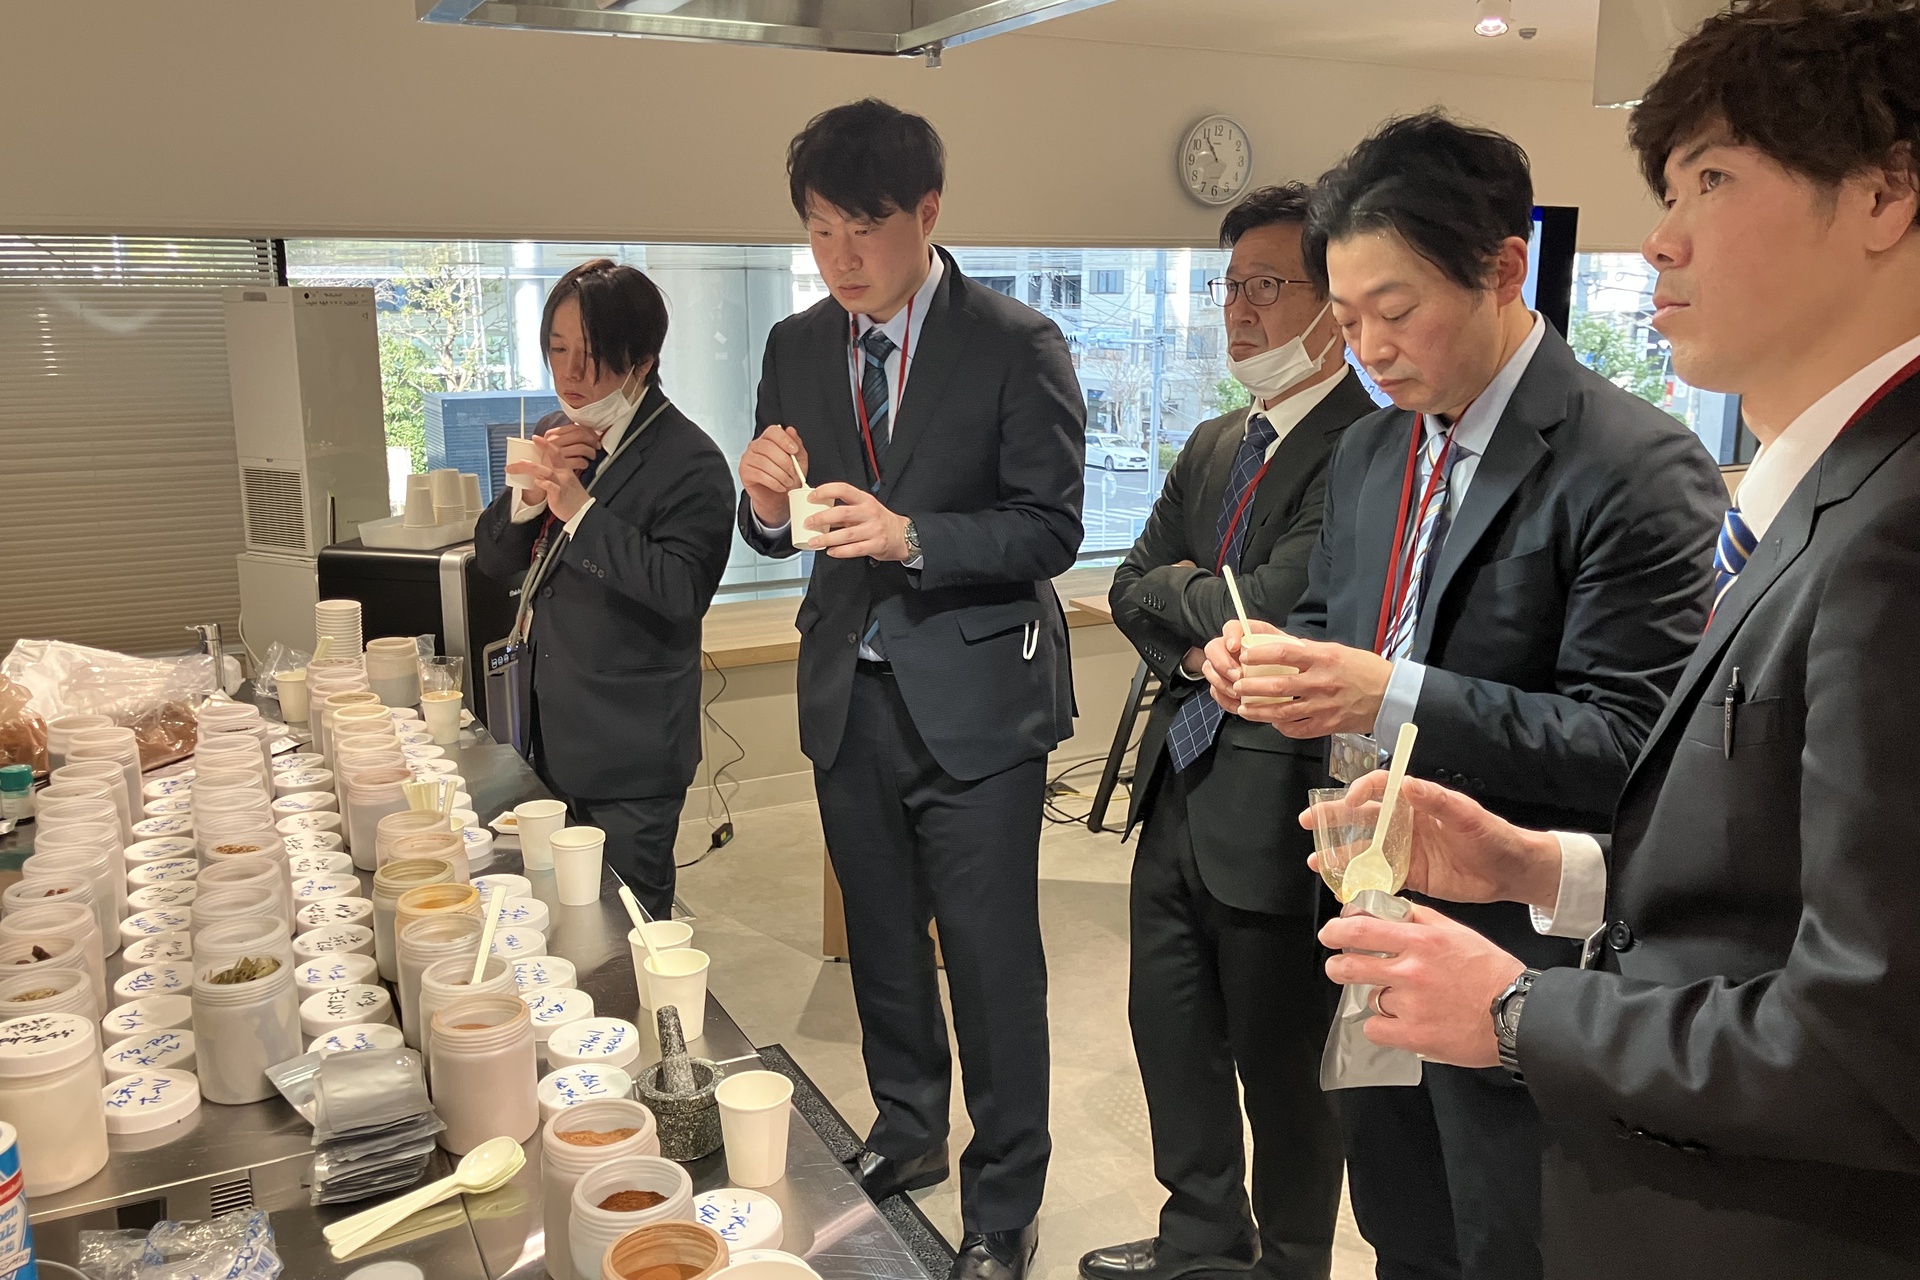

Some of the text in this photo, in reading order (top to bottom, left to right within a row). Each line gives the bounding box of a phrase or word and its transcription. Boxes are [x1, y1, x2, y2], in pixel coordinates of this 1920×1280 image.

[1203, 128, 1211, 140] 11
[1214, 125, 1224, 137] 12
[1228, 129, 1233, 140] 1
[1193, 139, 1202, 151] 10
[1235, 140, 1242, 152] 2
[1188, 153, 1196, 166] 9
[1237, 156, 1245, 168] 3
[1191, 170, 1198, 182] 8
[1232, 171, 1239, 182] 4
[1200, 181, 1207, 193] 7
[1211, 185, 1218, 197] 6
[1223, 182, 1230, 193] 5
[135, 1042, 180, 1066] ホール
[138, 1078, 172, 1106] ホール
